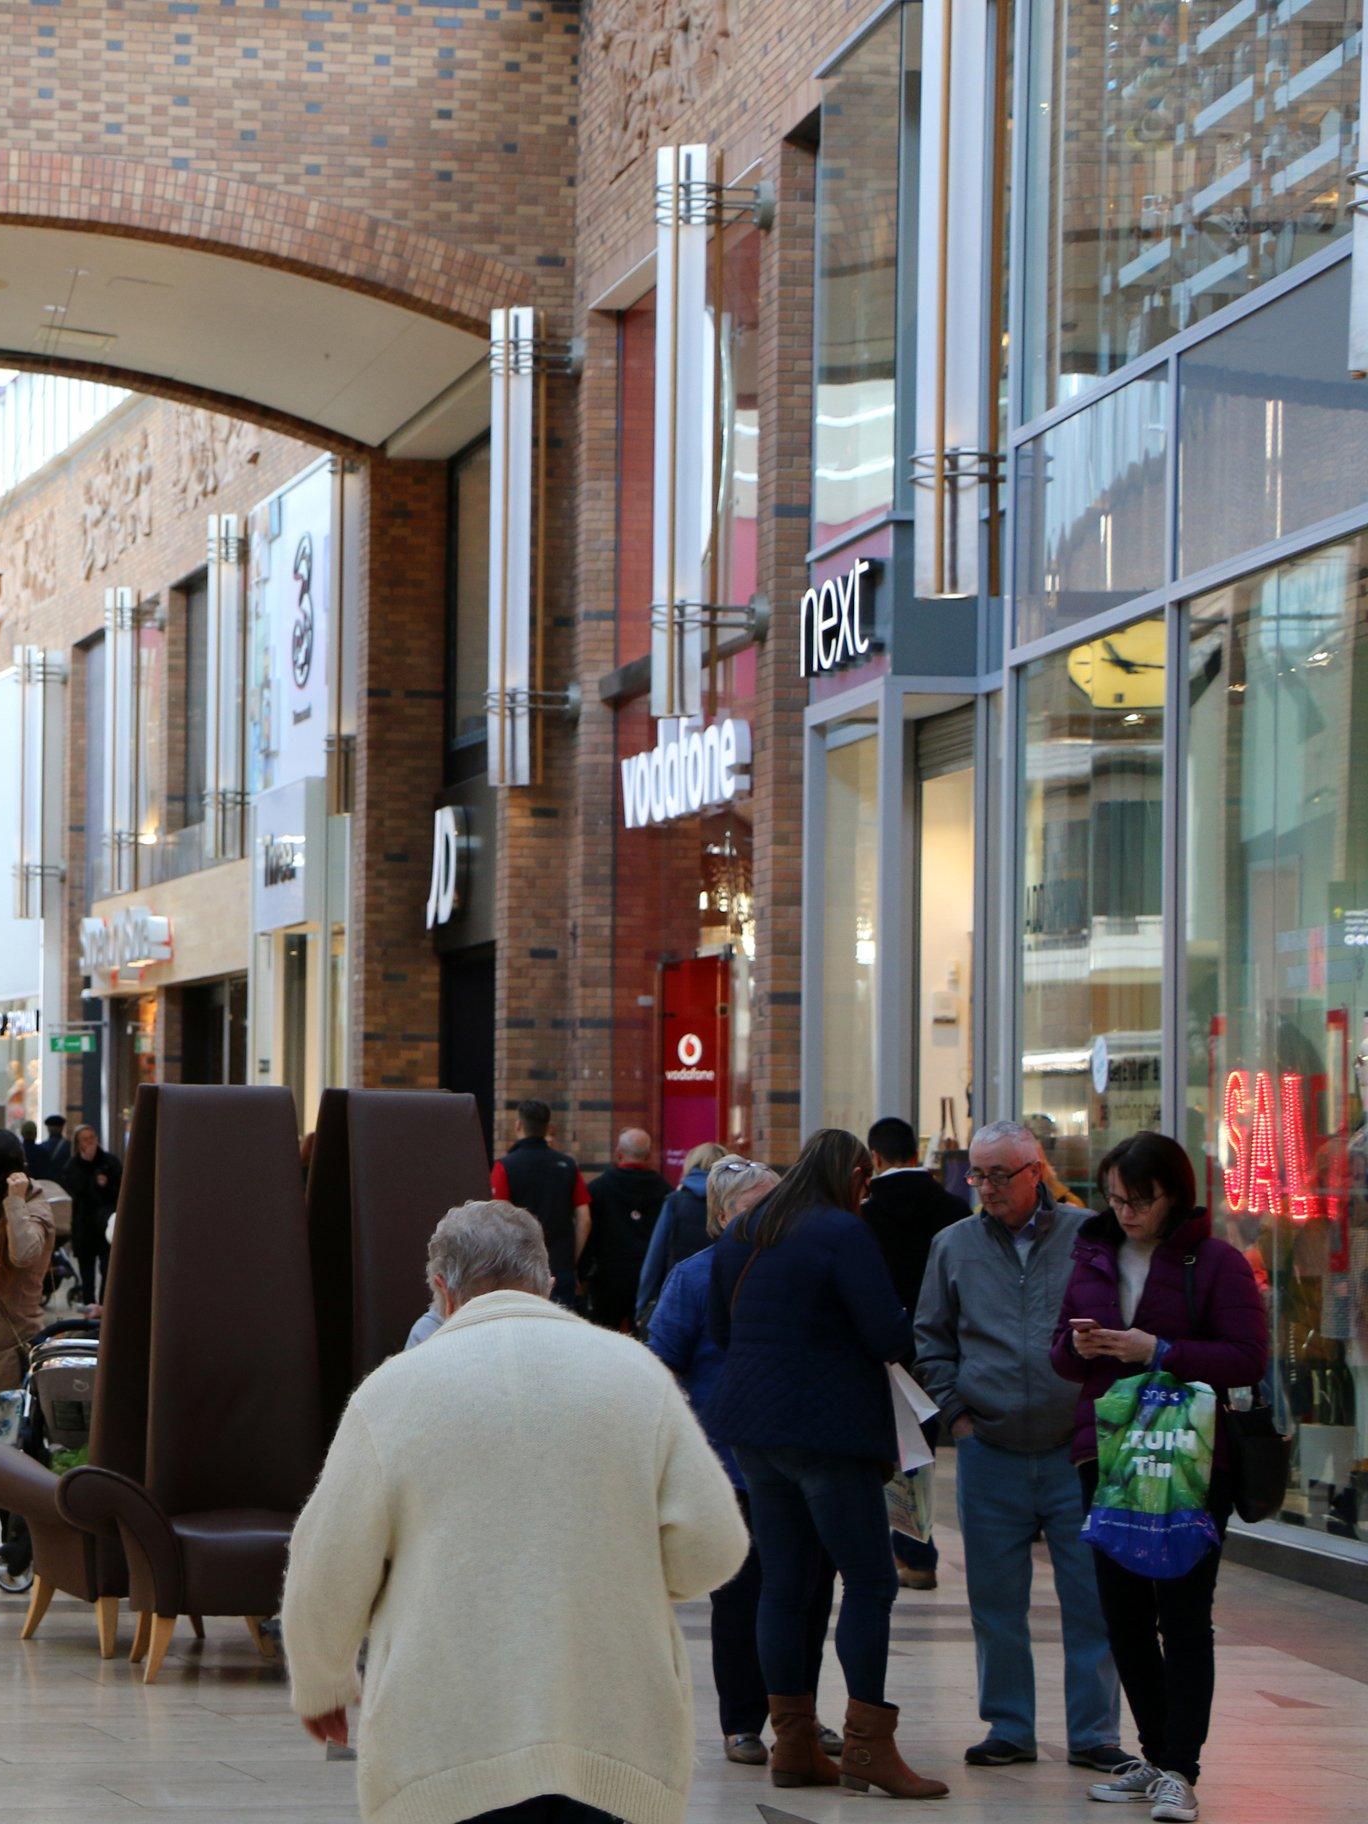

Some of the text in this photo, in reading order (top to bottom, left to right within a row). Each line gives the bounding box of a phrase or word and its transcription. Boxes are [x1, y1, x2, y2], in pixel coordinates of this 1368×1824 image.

[799, 557, 870, 678] next
[621, 716, 744, 829] vodafone
[426, 805, 457, 930] JD
[665, 1066, 715, 1081] vodafone
